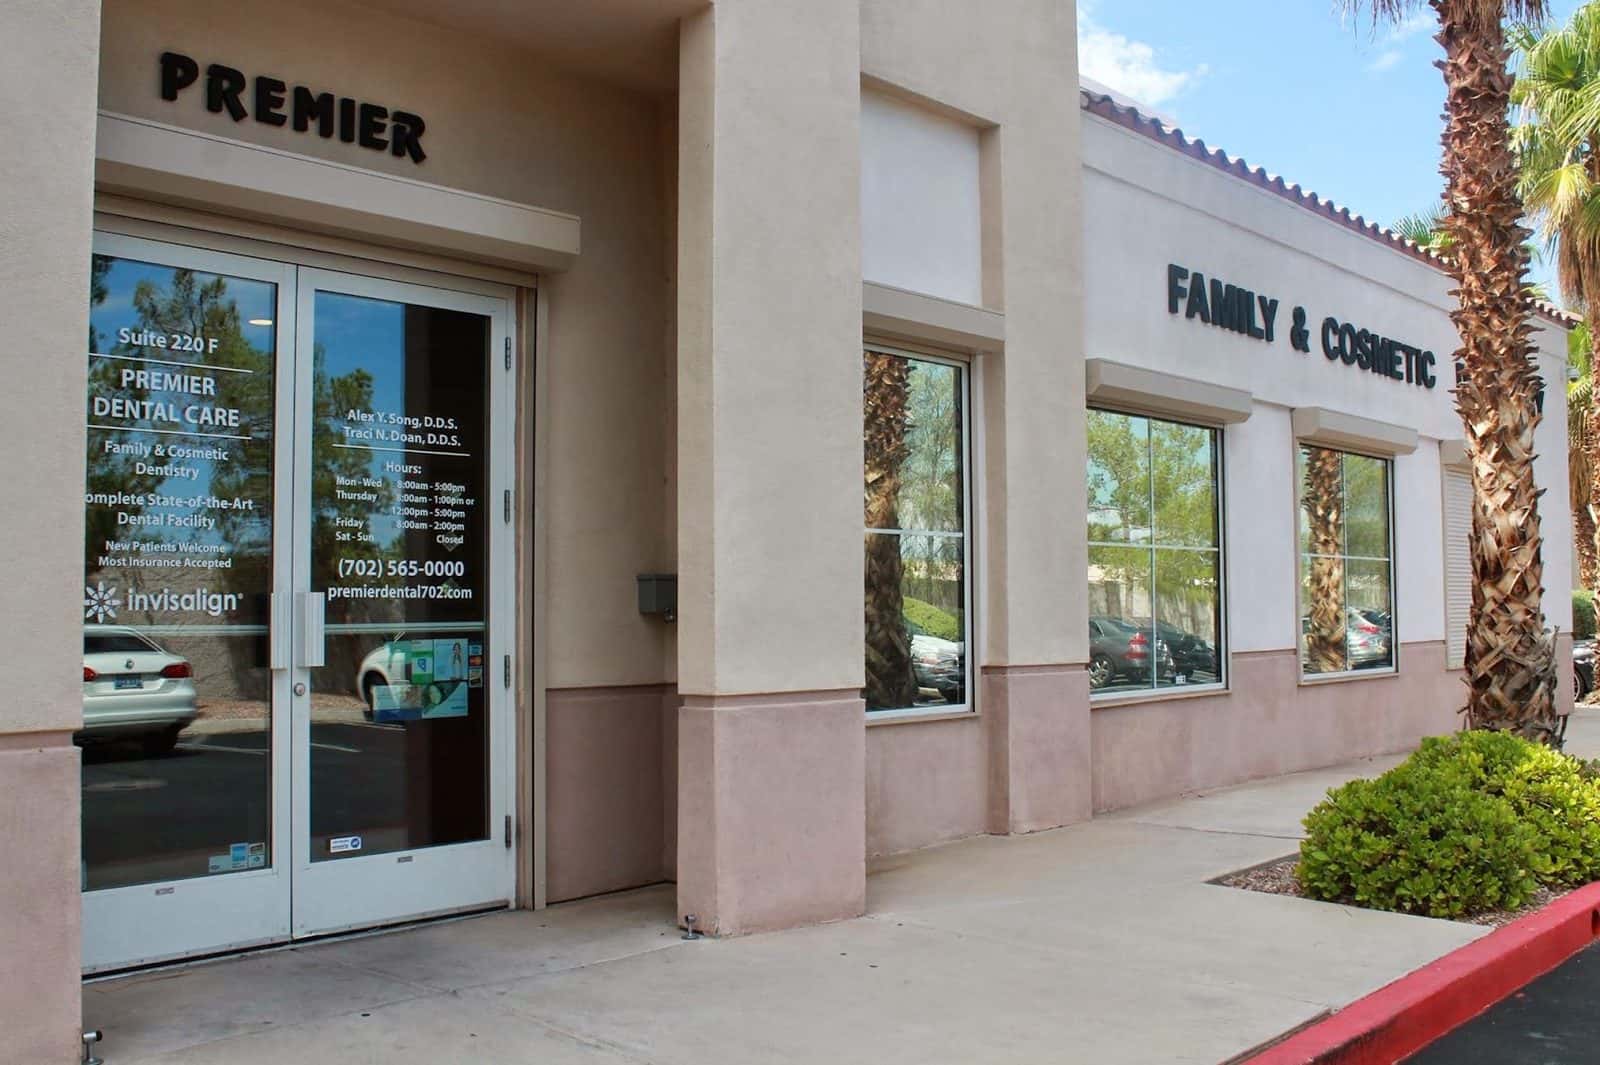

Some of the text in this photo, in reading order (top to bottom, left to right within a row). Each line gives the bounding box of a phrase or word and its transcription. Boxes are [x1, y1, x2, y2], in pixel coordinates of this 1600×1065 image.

[159, 51, 426, 164] PREMIER
[1167, 263, 1279, 342] FAMILY
[1290, 305, 1310, 353] &
[1322, 317, 1436, 389] COSMETIC
[119, 327, 219, 354] Suite 220 F
[121, 368, 216, 396] PREMIER
[93, 397, 240, 427] DENTAL CARE
[347, 409, 458, 430] Alex Y. Song, D.D.S.
[343, 426, 461, 446] Traci N. Doan, D.D.S.
[105, 440, 229, 461] Family & Cosmetic
[136, 462, 200, 480] Dentistry
[386, 461, 422, 474] Hours:
[336, 477, 356, 486] Mon
[362, 478, 382, 488] Wed
[397, 480, 428, 490] 8:00am
[434, 482, 465, 494] 5:00pm
[85, 491, 253, 511] omplete State-of-the-Art
[336, 490, 378, 503] Thursday
[434, 495, 464, 507] 1:00pm
[118, 512, 216, 530] Dental Facility
[392, 507, 428, 518] 12:00pm
[434, 508, 465, 520] 5:00pm
[336, 517, 364, 529] Friday
[396, 520, 428, 529] 8:00am
[434, 521, 465, 532] 2:00pm
[105, 540, 225, 553] New Patients Welcome
[336, 531, 350, 541] Sat
[357, 532, 375, 542] Sun
[436, 534, 464, 545] Closed
[98, 556, 232, 570] Most Insurance Accepted
[338, 558, 465, 578] (702) 565-0000
[328, 584, 472, 601] premierdental702.com
